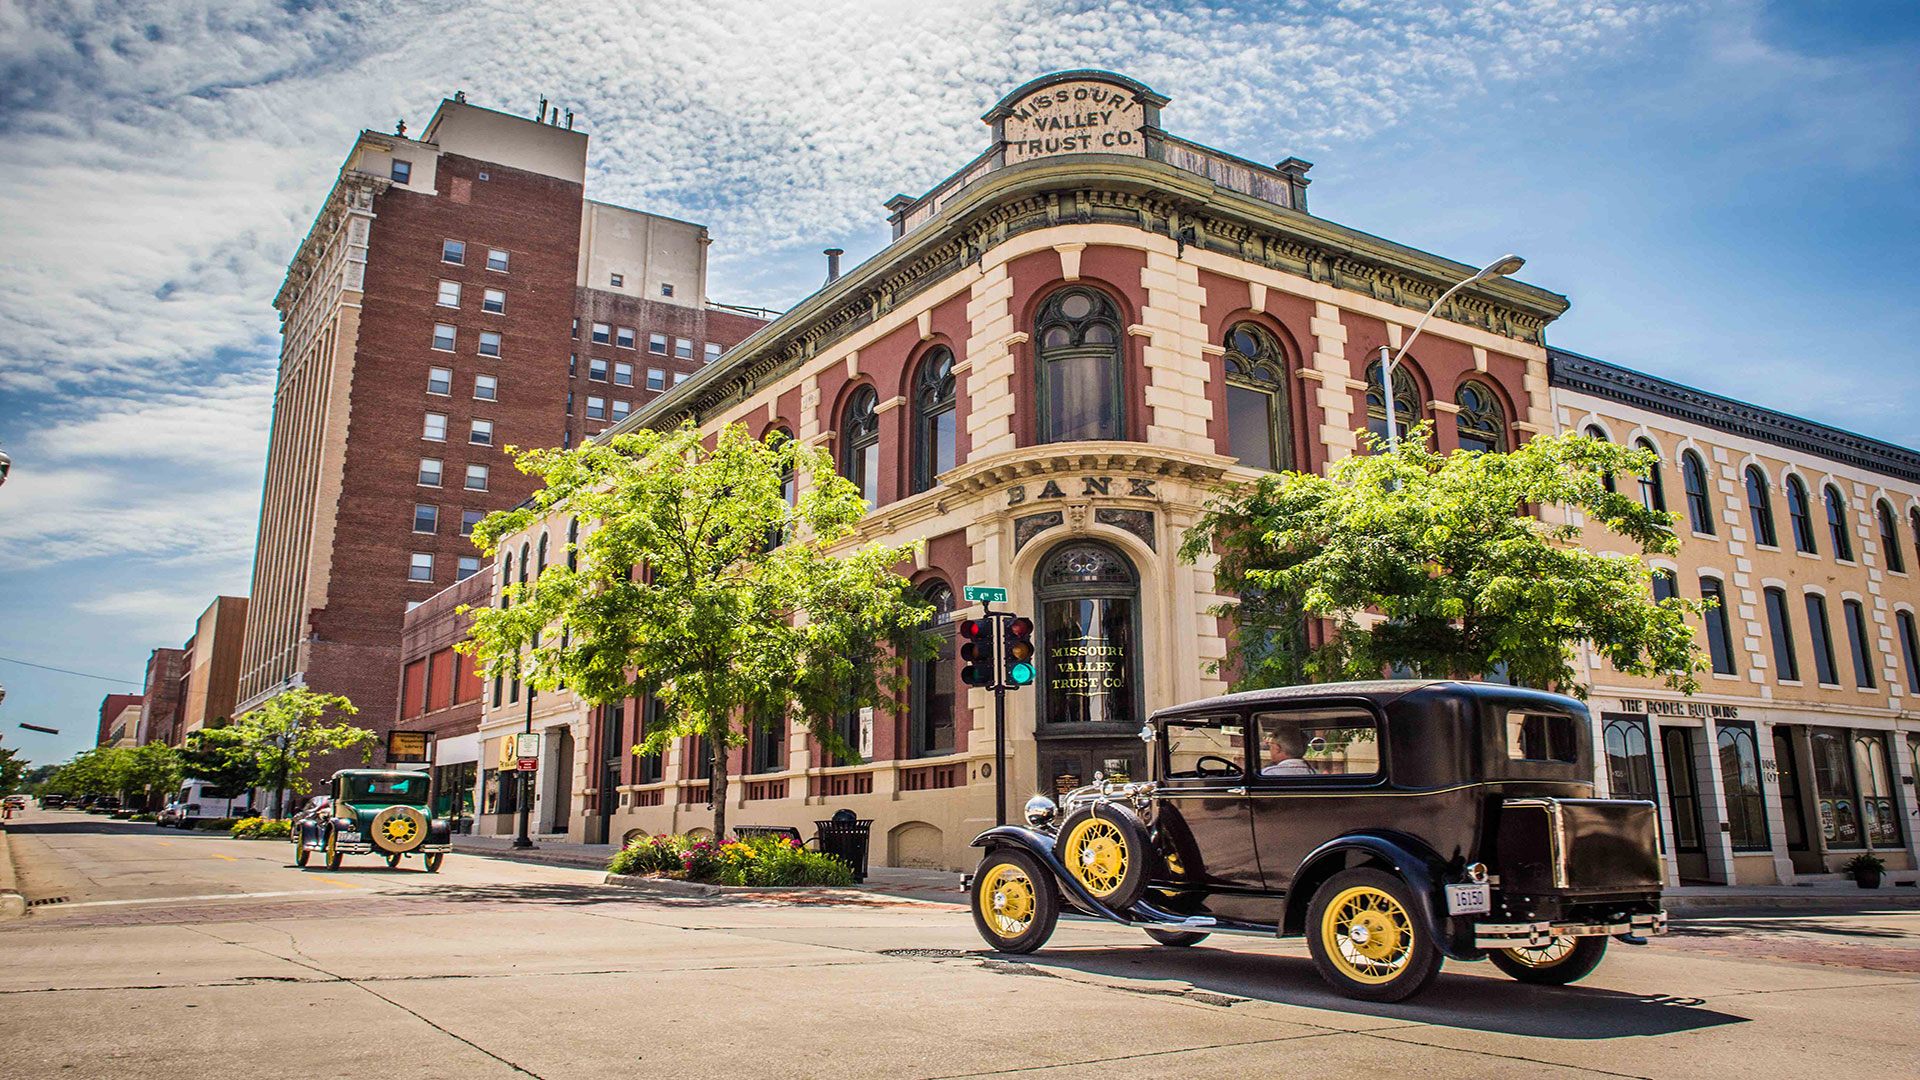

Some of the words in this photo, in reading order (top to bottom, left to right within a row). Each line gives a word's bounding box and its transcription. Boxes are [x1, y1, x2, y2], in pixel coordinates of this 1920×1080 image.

[1013, 87, 1135, 124] MISSOURI
[1033, 110, 1113, 132] VALLEY
[1014, 134, 1092, 156] TRUST
[1101, 130, 1138, 148] CO.
[1008, 477, 1156, 506] BANK
[968, 592, 974, 600] S
[993, 593, 1003, 601] ST
[1051, 645, 1124, 658] MISSOURI
[1058, 662, 1117, 673] VALLEY
[1052, 677, 1099, 690] TRUST
[1103, 677, 1124, 689] CO.
[1620, 699, 1643, 713] THE
[1688, 703, 1739, 719] BUILDING
[1763, 772, 1776, 782] 107
[1455, 890, 1484, 907] 16150
